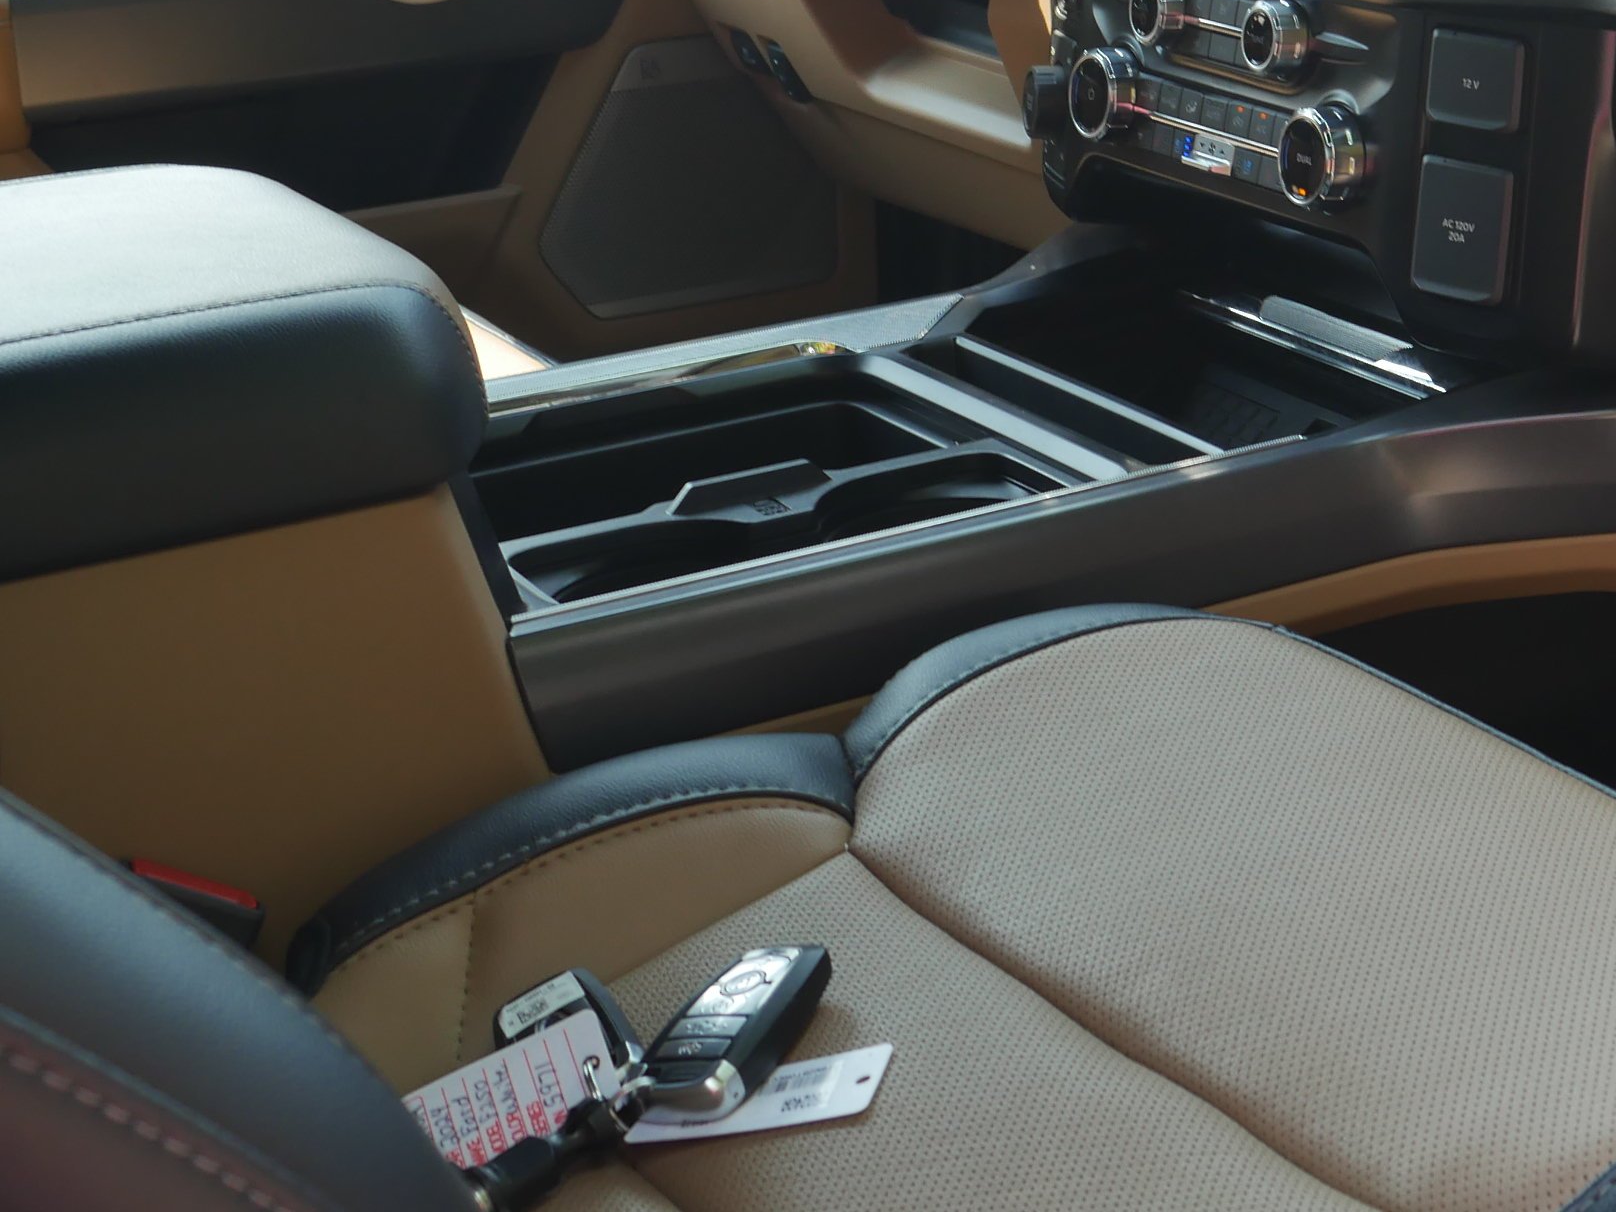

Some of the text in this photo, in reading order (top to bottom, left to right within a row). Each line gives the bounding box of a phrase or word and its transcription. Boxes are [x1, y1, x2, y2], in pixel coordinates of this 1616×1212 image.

[1296, 152, 1313, 167] DUAL
[1441, 217, 1475, 234] AC 120V
